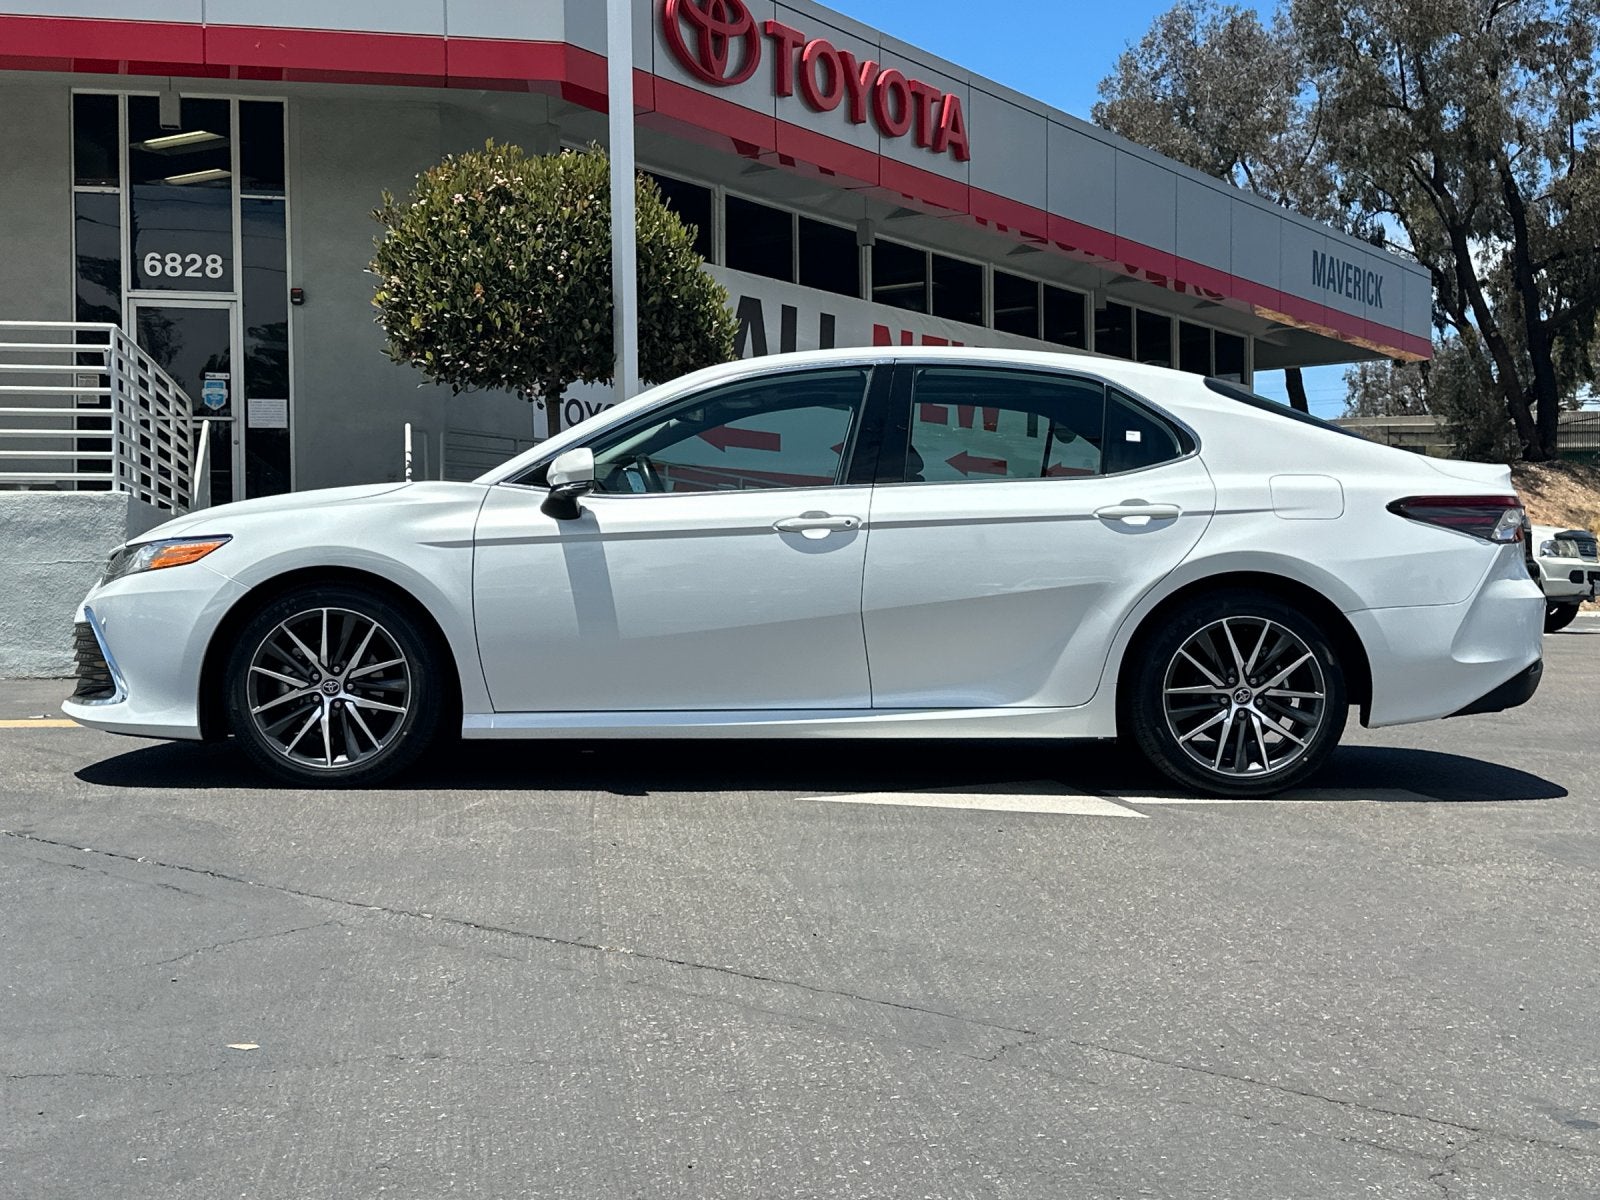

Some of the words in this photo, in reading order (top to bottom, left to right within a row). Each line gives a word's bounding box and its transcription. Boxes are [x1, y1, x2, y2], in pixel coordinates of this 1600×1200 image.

[764, 20, 970, 162] TOYOTA
[144, 252, 223, 279] 6828
[1312, 249, 1383, 309] MAVERICK
